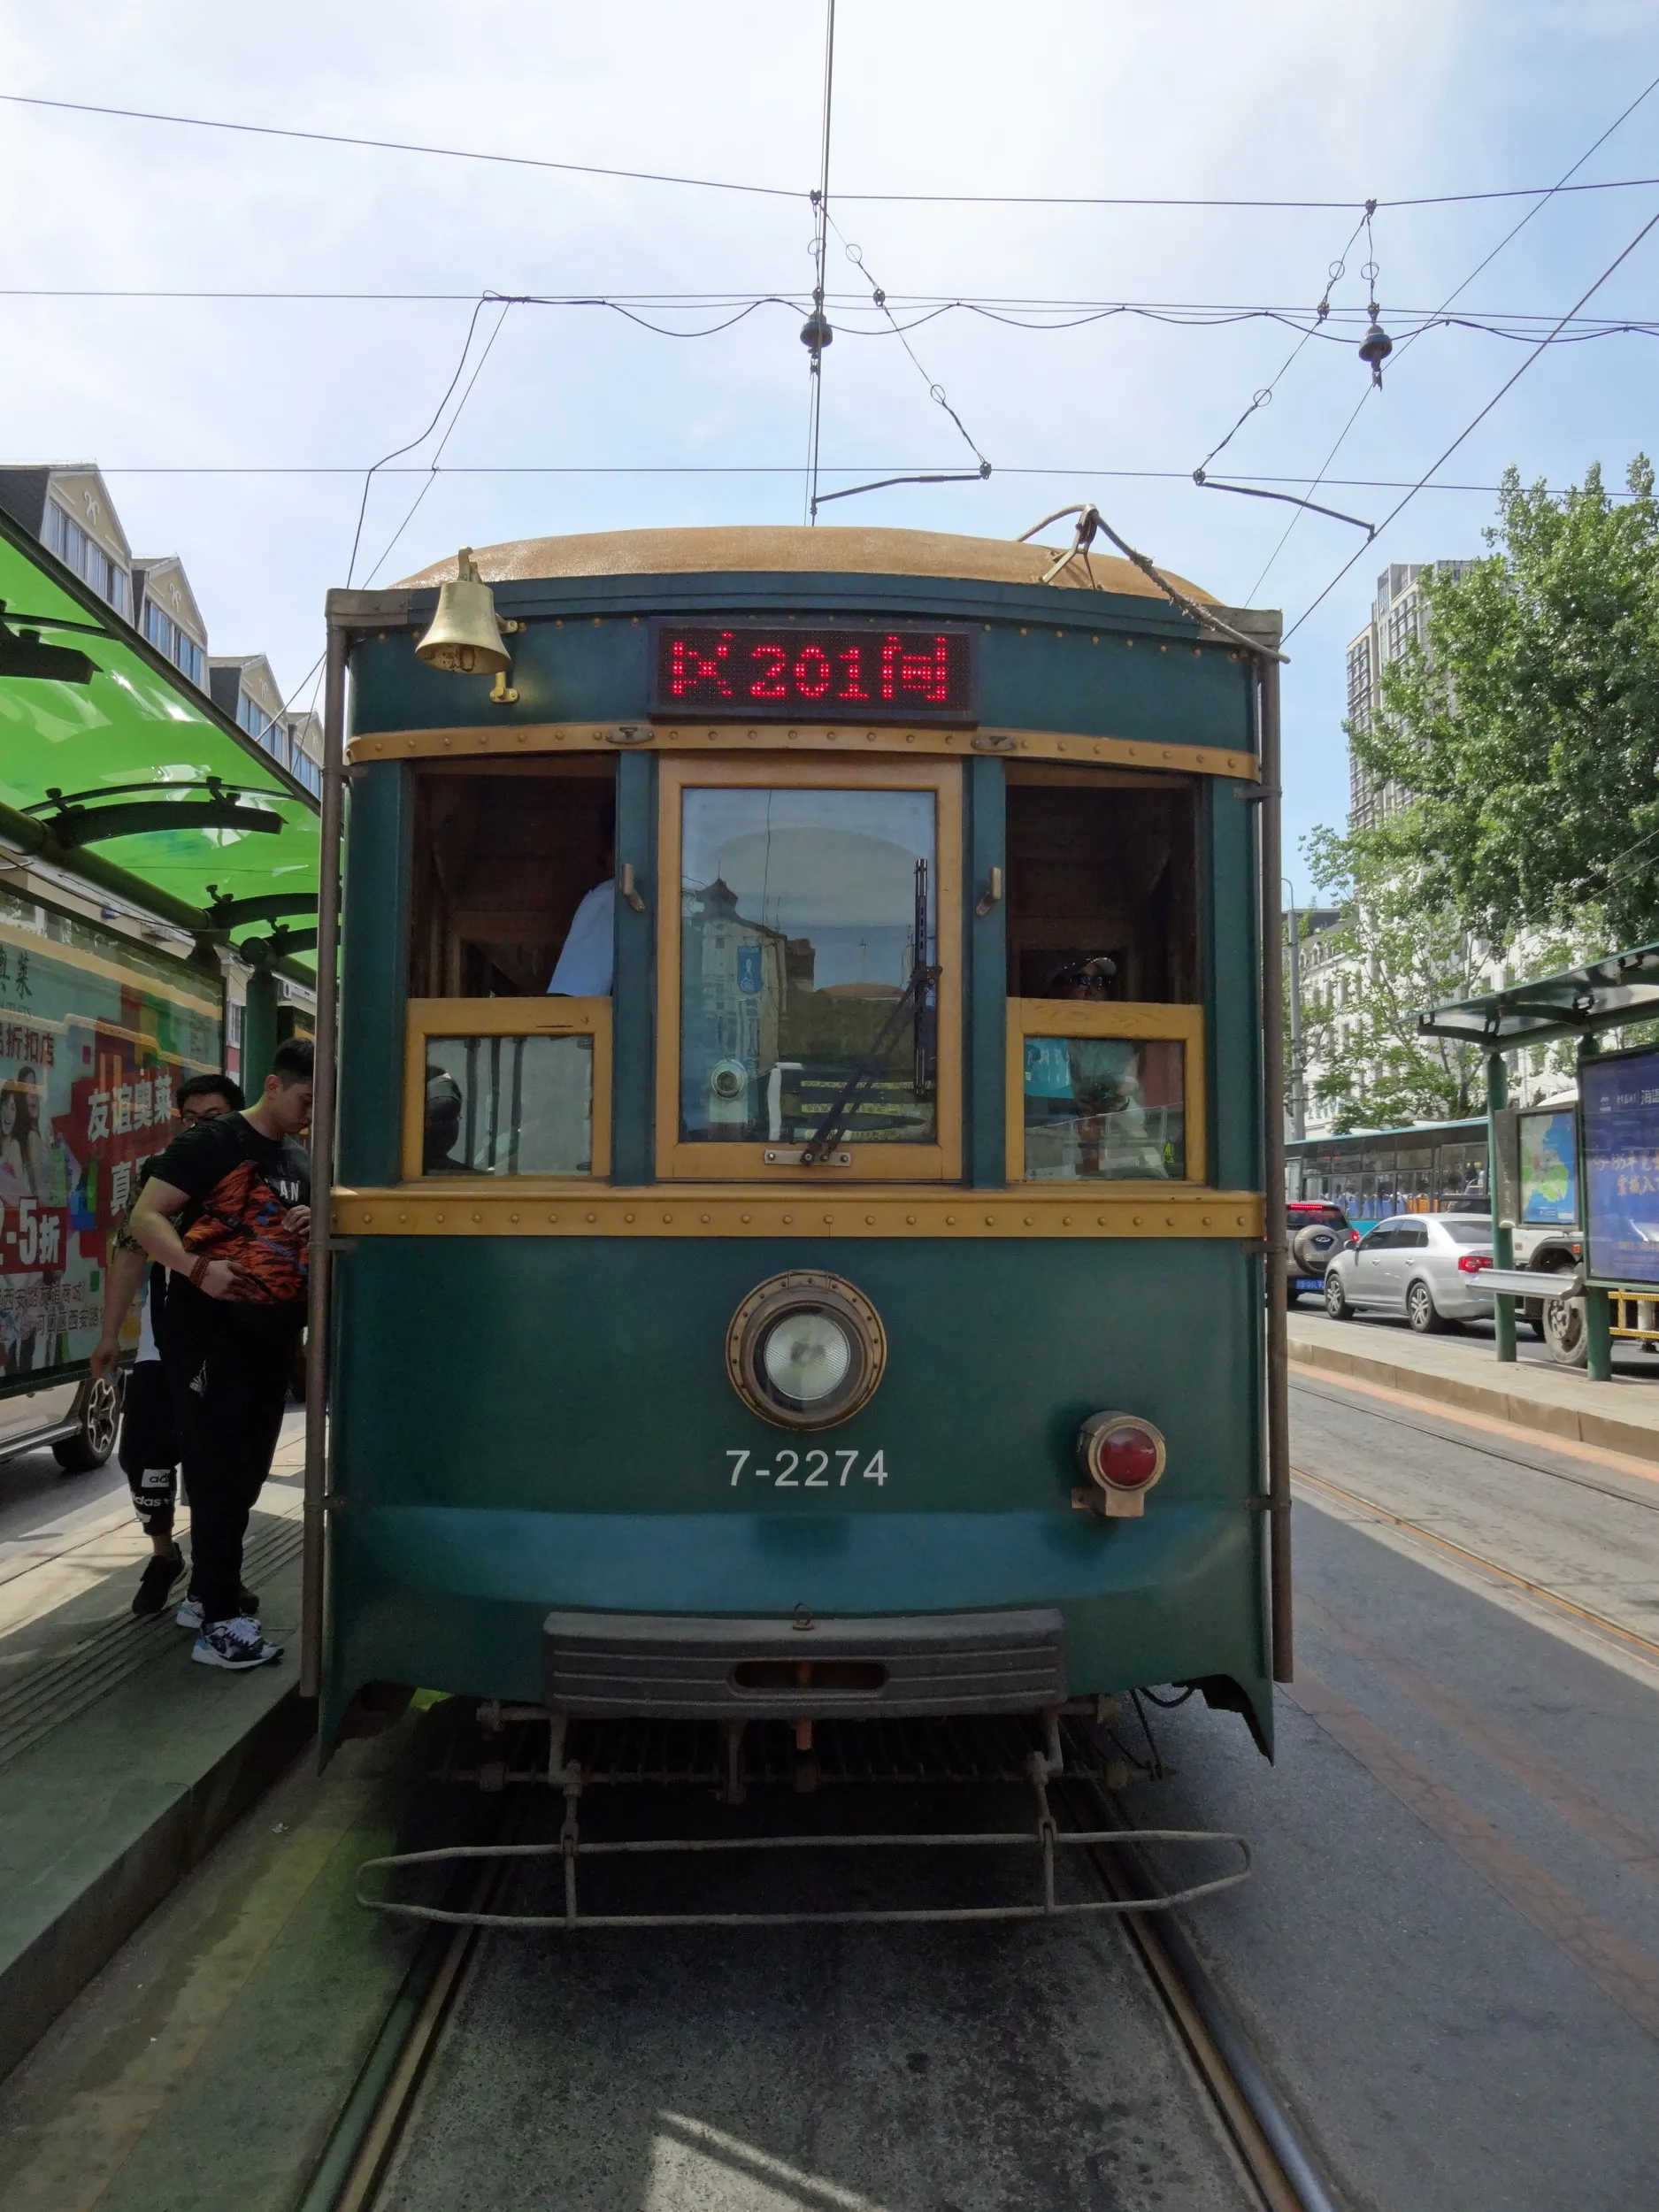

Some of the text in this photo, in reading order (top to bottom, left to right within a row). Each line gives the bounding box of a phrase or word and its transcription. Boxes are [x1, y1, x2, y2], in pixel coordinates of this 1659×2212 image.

[0, 1022, 55, 1067] 折扣店
[88, 1075, 173, 1142] 友谊奥莱
[726, 1448, 888, 1486] 7-2274
